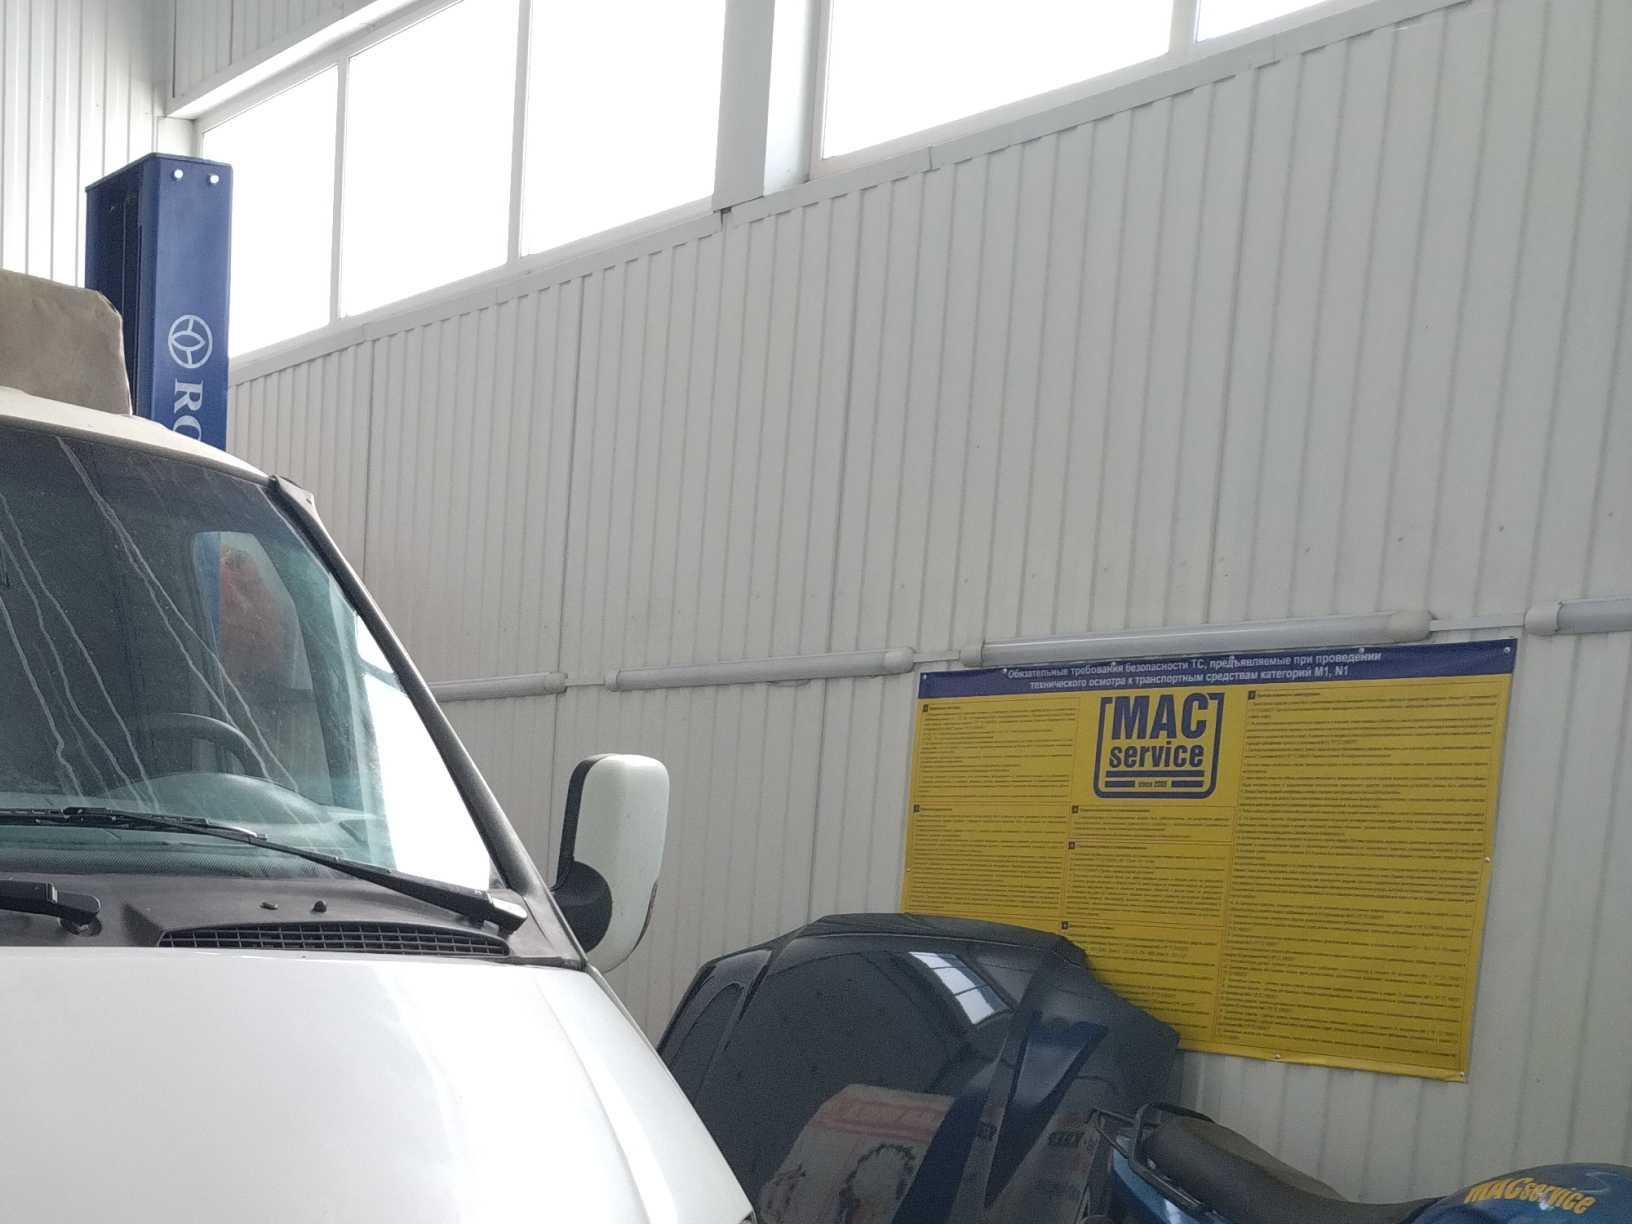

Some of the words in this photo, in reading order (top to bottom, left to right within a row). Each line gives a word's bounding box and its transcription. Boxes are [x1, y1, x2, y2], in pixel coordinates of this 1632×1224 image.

[1008, 667, 1069, 679] Обязательные
[1071, 664, 1124, 676] требования
[1125, 660, 1189, 673] безопасности
[1293, 654, 1313, 666] при
[1316, 651, 1382, 665] проведении
[1030, 680, 1087, 690] технического
[1089, 677, 1126, 688] осмотра
[1135, 674, 1203, 686] транспортным
[1206, 671, 1258, 683] средствам
[1260, 667, 1312, 680] категорий
[1111, 692, 1209, 740] MAC
[1109, 741, 1204, 768] service
